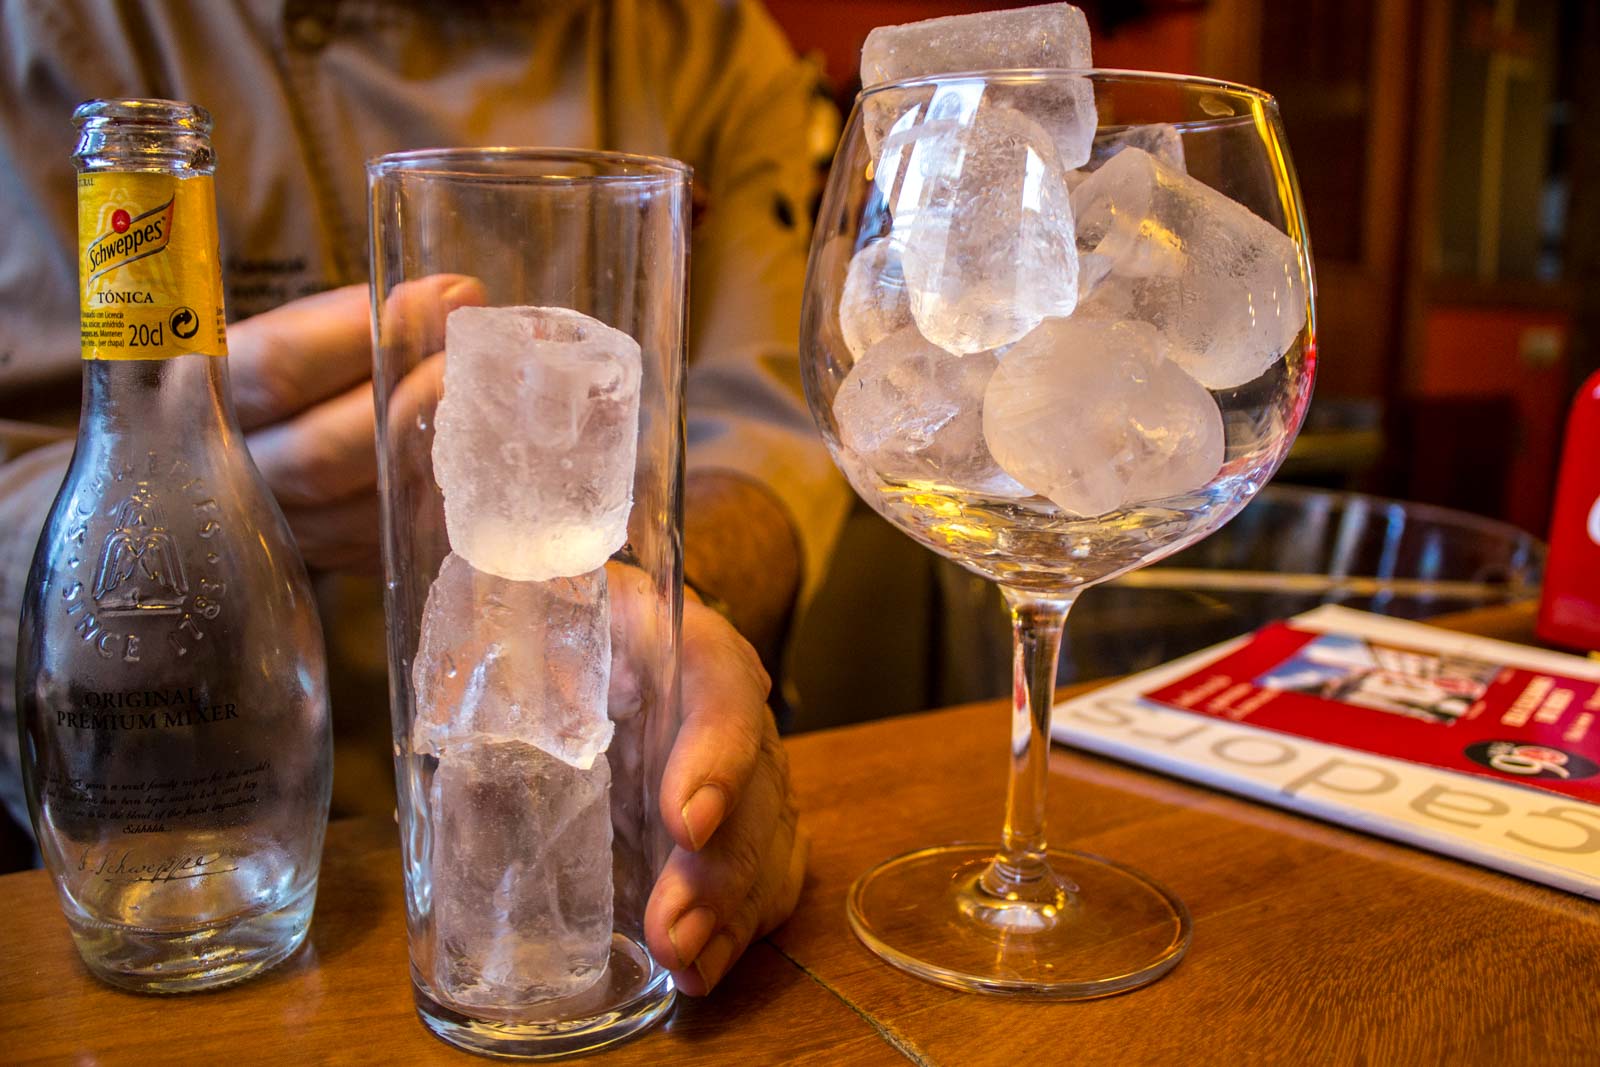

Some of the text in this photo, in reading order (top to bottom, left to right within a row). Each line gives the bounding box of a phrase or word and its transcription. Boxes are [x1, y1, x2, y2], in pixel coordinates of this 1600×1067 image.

[89, 219, 164, 273] Schweppes
[97, 290, 154, 304] TÓNICA
[128, 322, 164, 347] 20cl
[84, 687, 200, 708] ORIGINAL
[56, 703, 240, 730] PREMIUM MIXER
